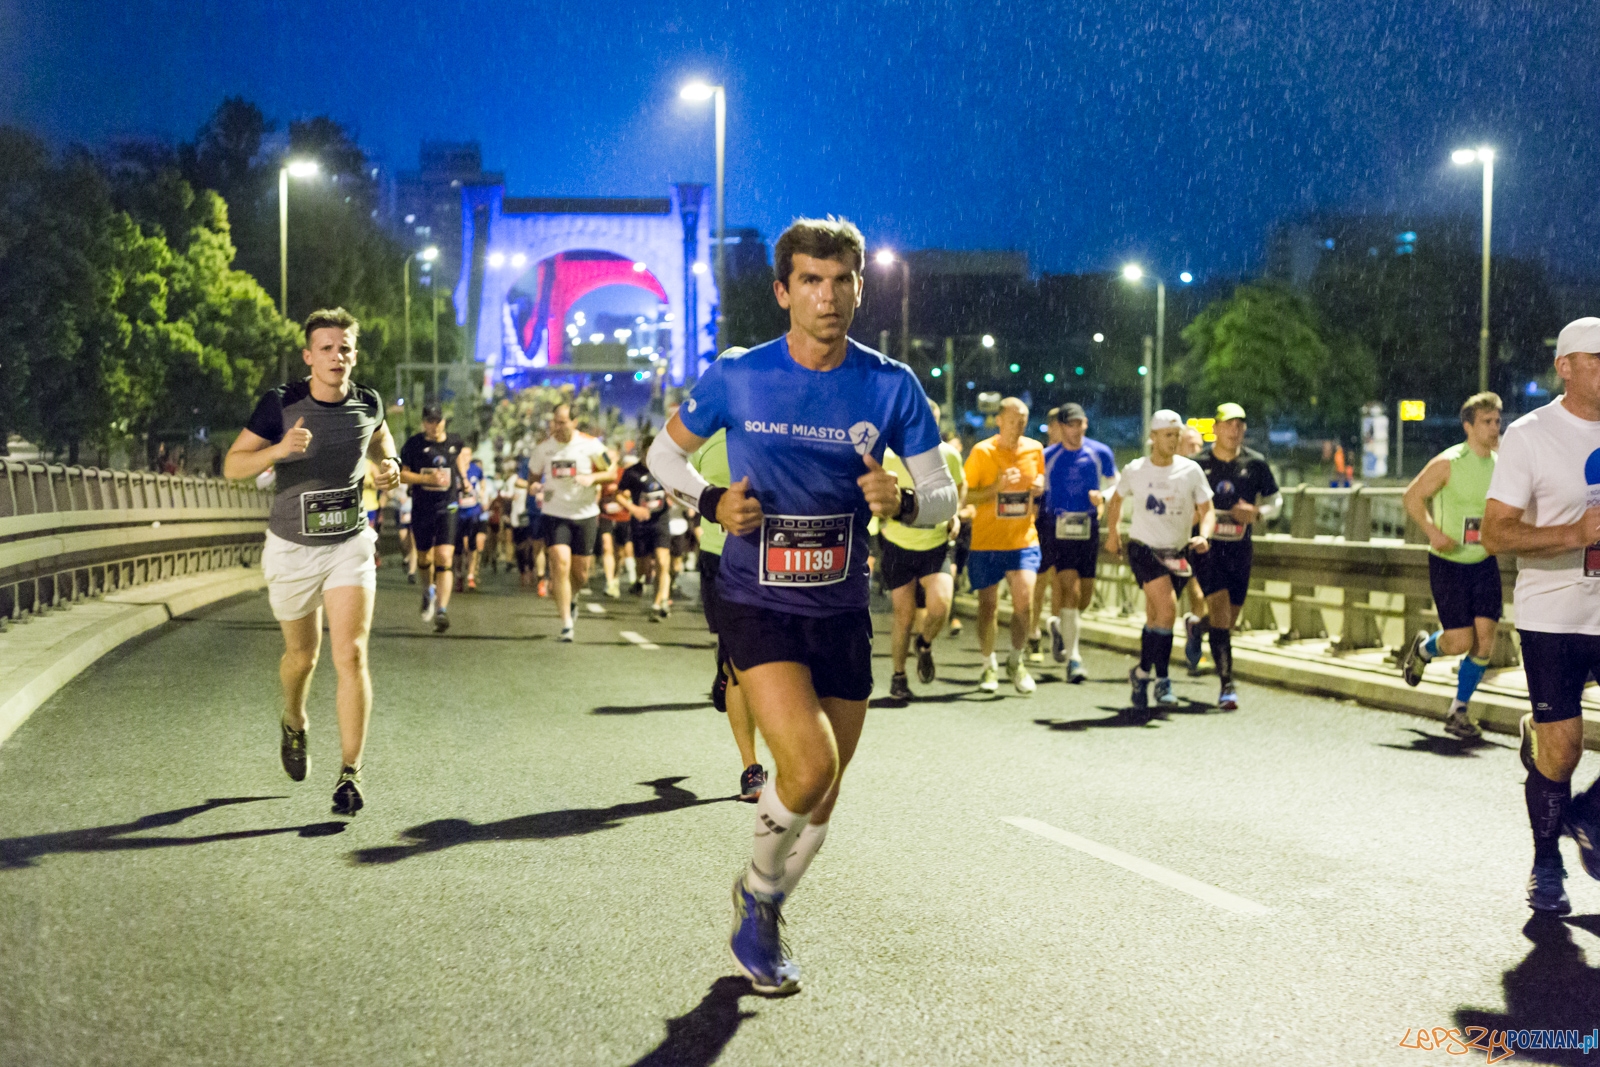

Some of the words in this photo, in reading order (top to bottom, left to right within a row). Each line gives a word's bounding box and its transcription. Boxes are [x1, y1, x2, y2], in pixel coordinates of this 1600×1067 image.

[744, 420, 788, 435] SOLNE
[792, 424, 846, 440] MIASTO
[318, 511, 348, 526] 3401
[783, 549, 834, 571] 11139
